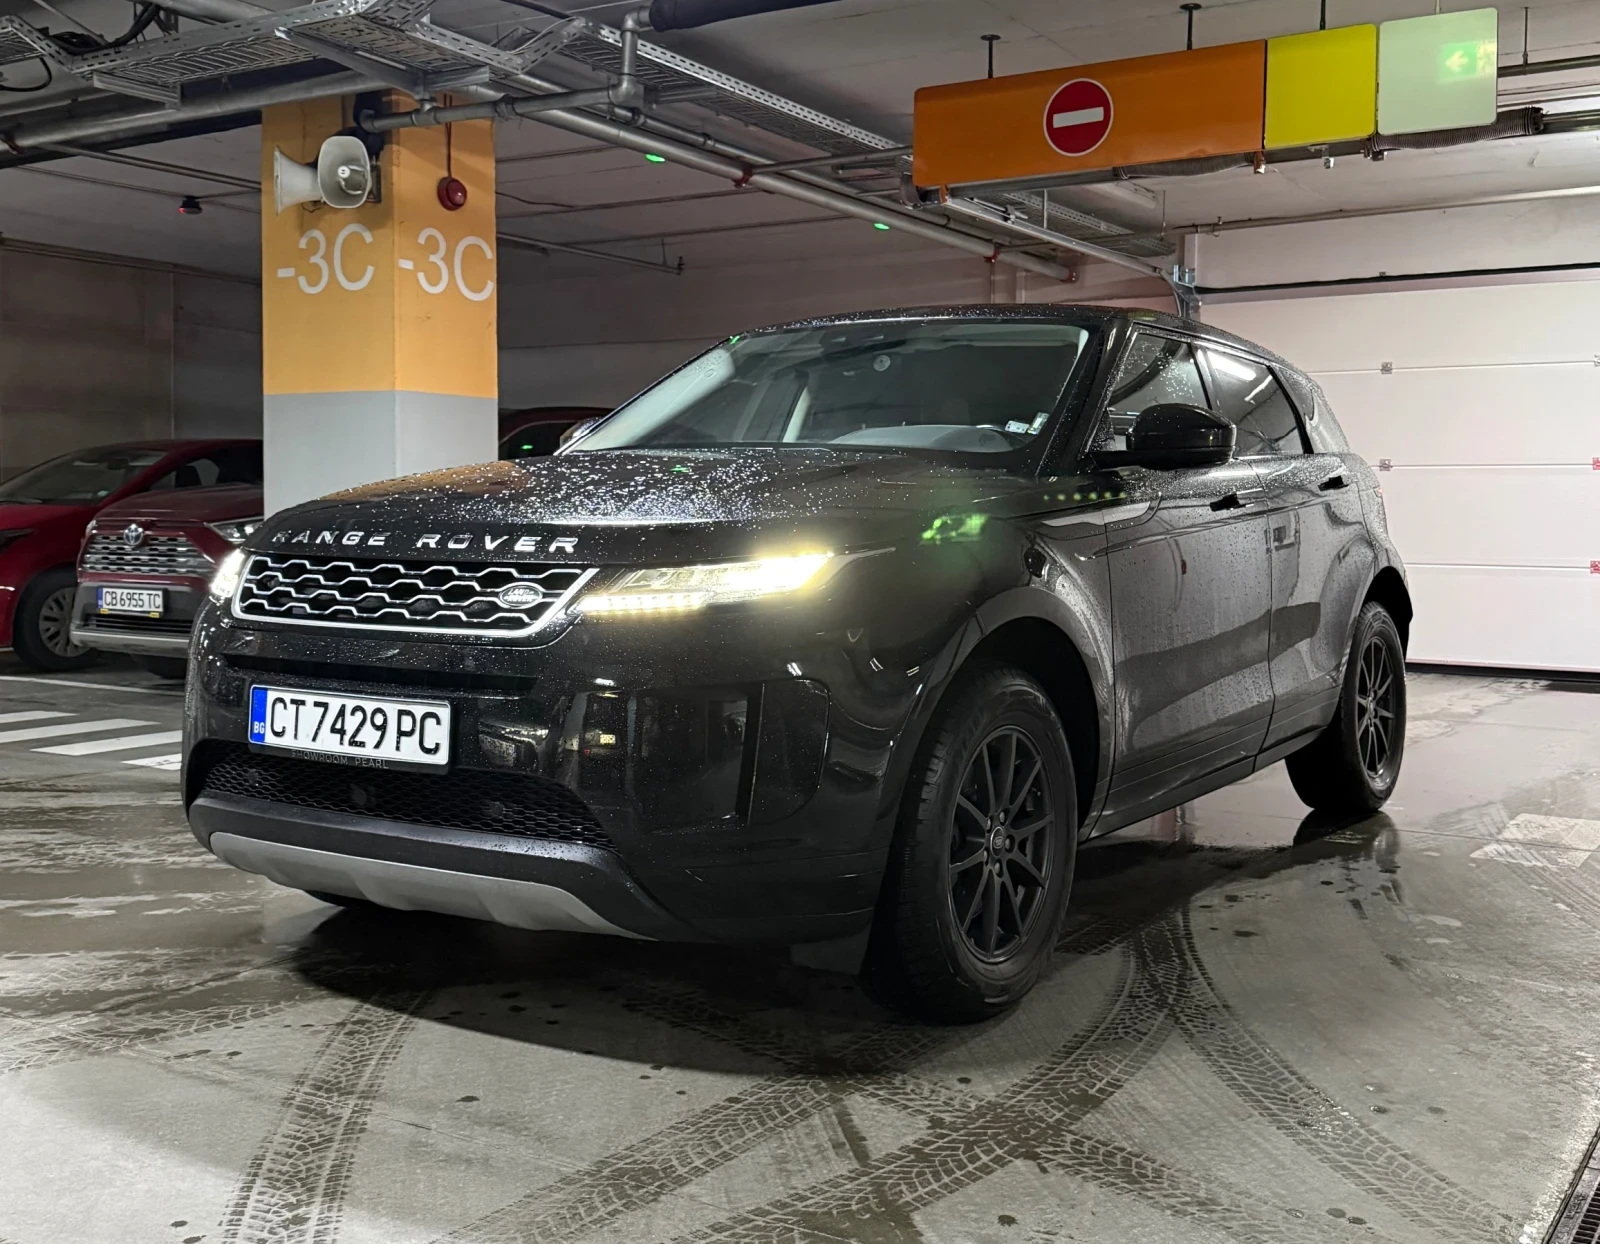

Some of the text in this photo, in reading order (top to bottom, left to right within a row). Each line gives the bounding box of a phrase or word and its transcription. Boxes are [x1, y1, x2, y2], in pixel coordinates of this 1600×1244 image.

[277, 223, 375, 294] -3C
[398, 227, 494, 302] -3C
[271, 529, 578, 553] RANGE ROVER
[104, 591, 161, 609] CB 6955 TC
[253, 720, 265, 734] BG
[270, 697, 442, 756] CT 7429 PC
[291, 749, 389, 769] SHOWROOM PEARL
